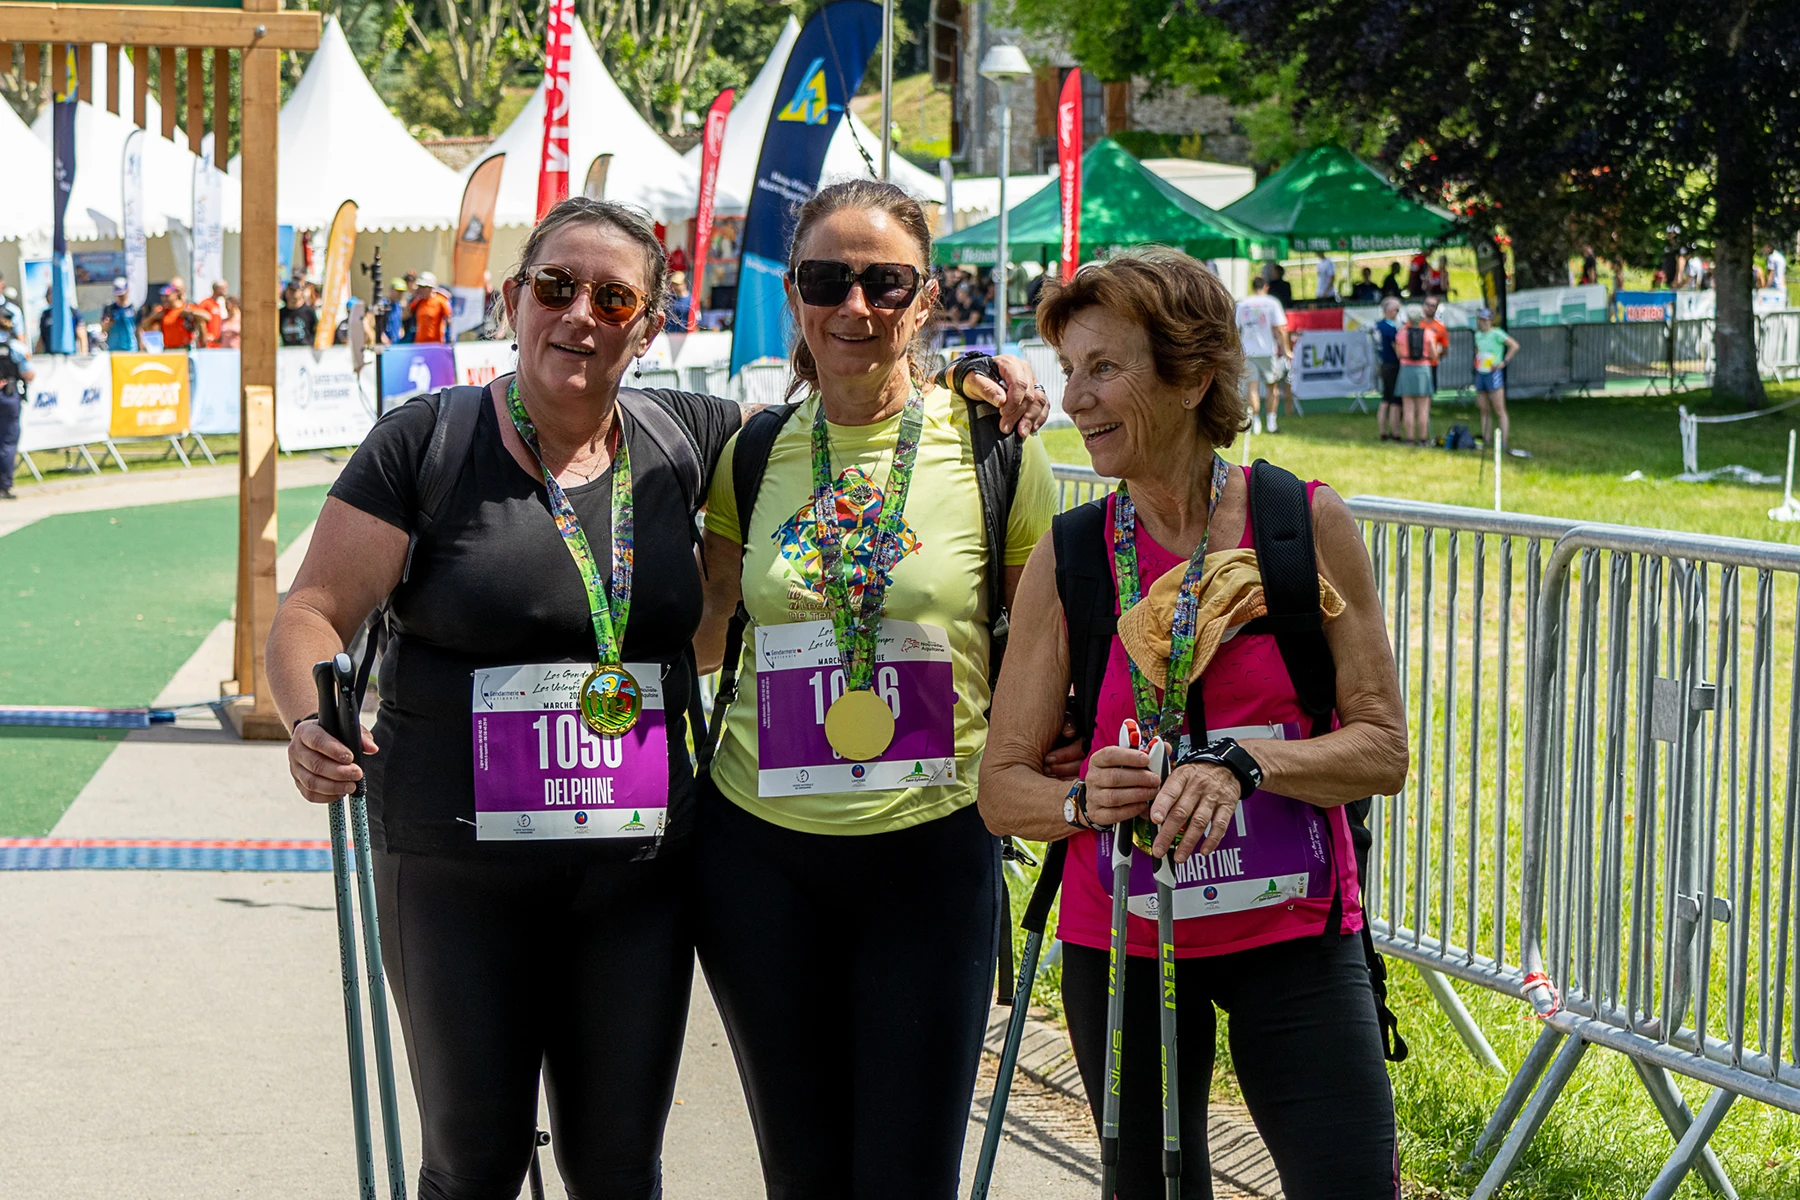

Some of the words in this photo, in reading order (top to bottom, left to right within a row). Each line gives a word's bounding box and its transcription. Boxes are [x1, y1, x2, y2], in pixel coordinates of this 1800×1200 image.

[1351, 234, 1422, 250] Heineken
[1626, 304, 1665, 321] HARIBO
[1302, 344, 1346, 368] ELAN
[818, 627, 832, 638] Les
[771, 648, 796, 656] Gendarmerie
[808, 639, 824, 650] Les
[818, 657, 843, 666] MARCH
[544, 670, 560, 681] Les
[533, 684, 549, 694] Les
[809, 666, 901, 724] 106
[533, 714, 622, 770] 1050
[544, 777, 614, 806] DELPHINE
[1174, 848, 1244, 884] MARTINE
[1162, 942, 1176, 1010] LEKI
[1111, 1028, 1122, 1096] SPIN
